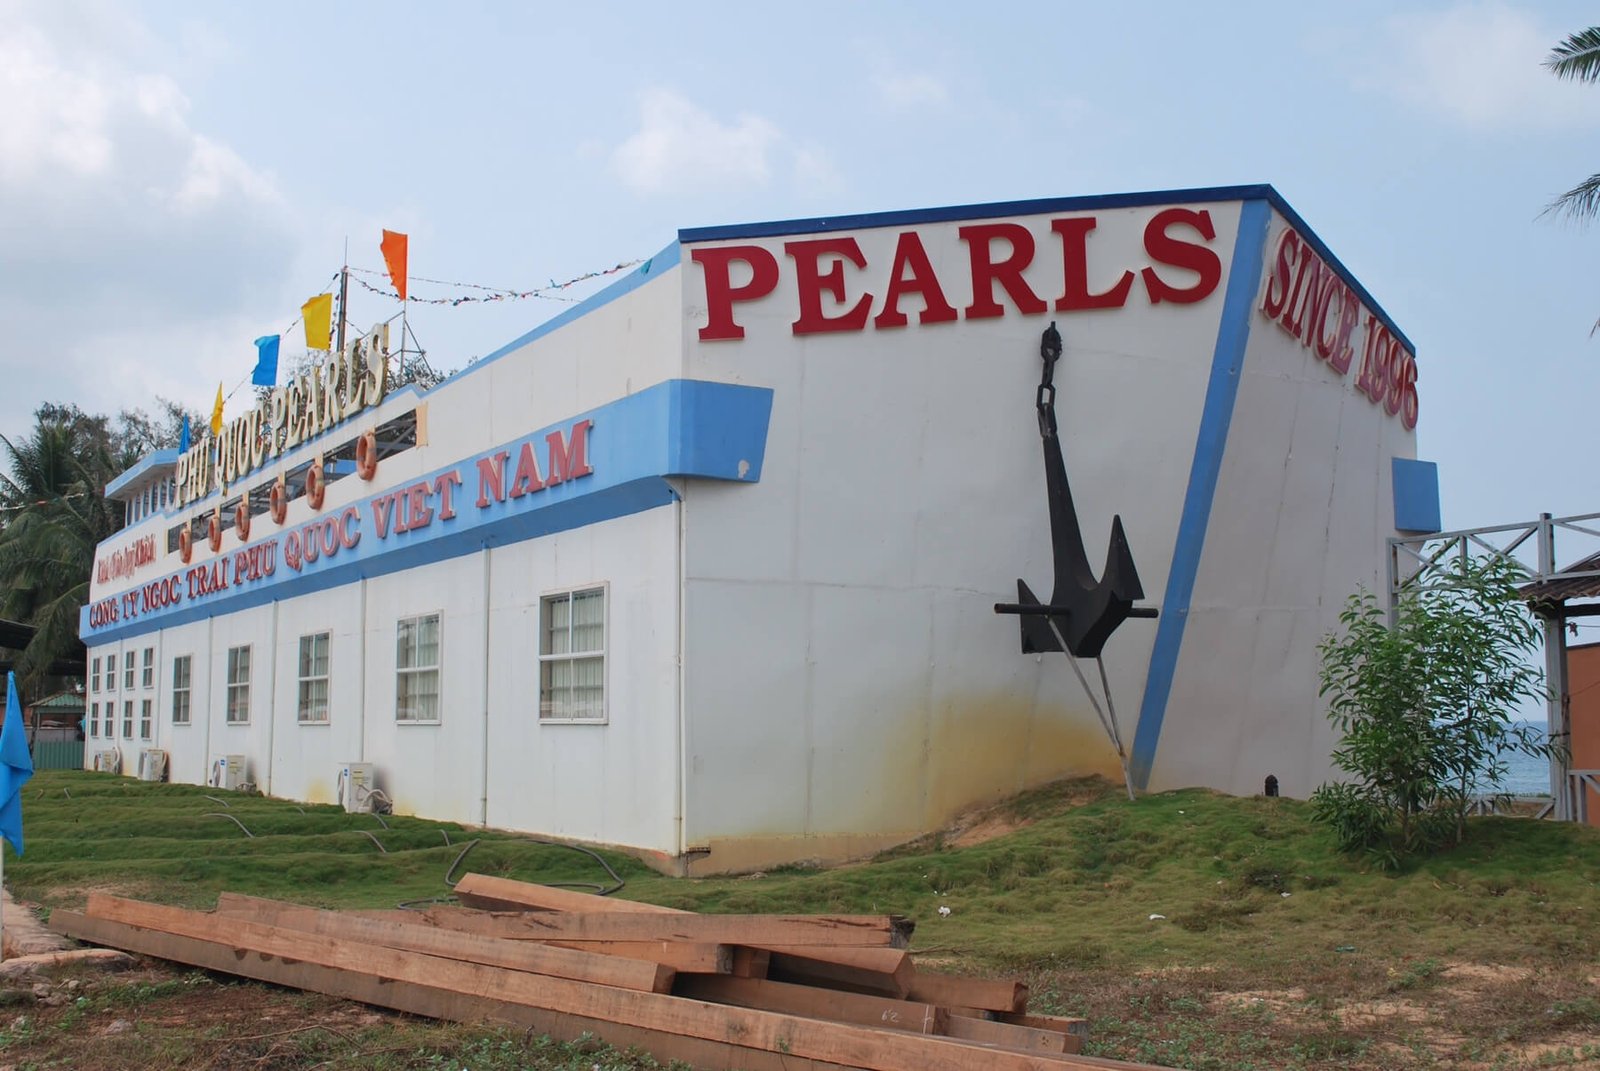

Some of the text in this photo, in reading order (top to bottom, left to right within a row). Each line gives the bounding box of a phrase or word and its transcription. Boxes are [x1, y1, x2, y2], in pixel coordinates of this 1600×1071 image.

[690, 207, 1223, 341] PEARLS
[1259, 227, 1419, 431] SINCE 1996
[173, 322, 389, 509] PHU QUOC PEARLS
[89, 598, 119, 629] CONG
[122, 590, 140, 619] TY
[142, 575, 182, 614] NGOC
[186, 557, 230, 600] TRAI
[233, 539, 278, 586] PHU
[284, 506, 362, 573] QUOC
[371, 468, 463, 540] VIET
[475, 418, 595, 510] NAM
